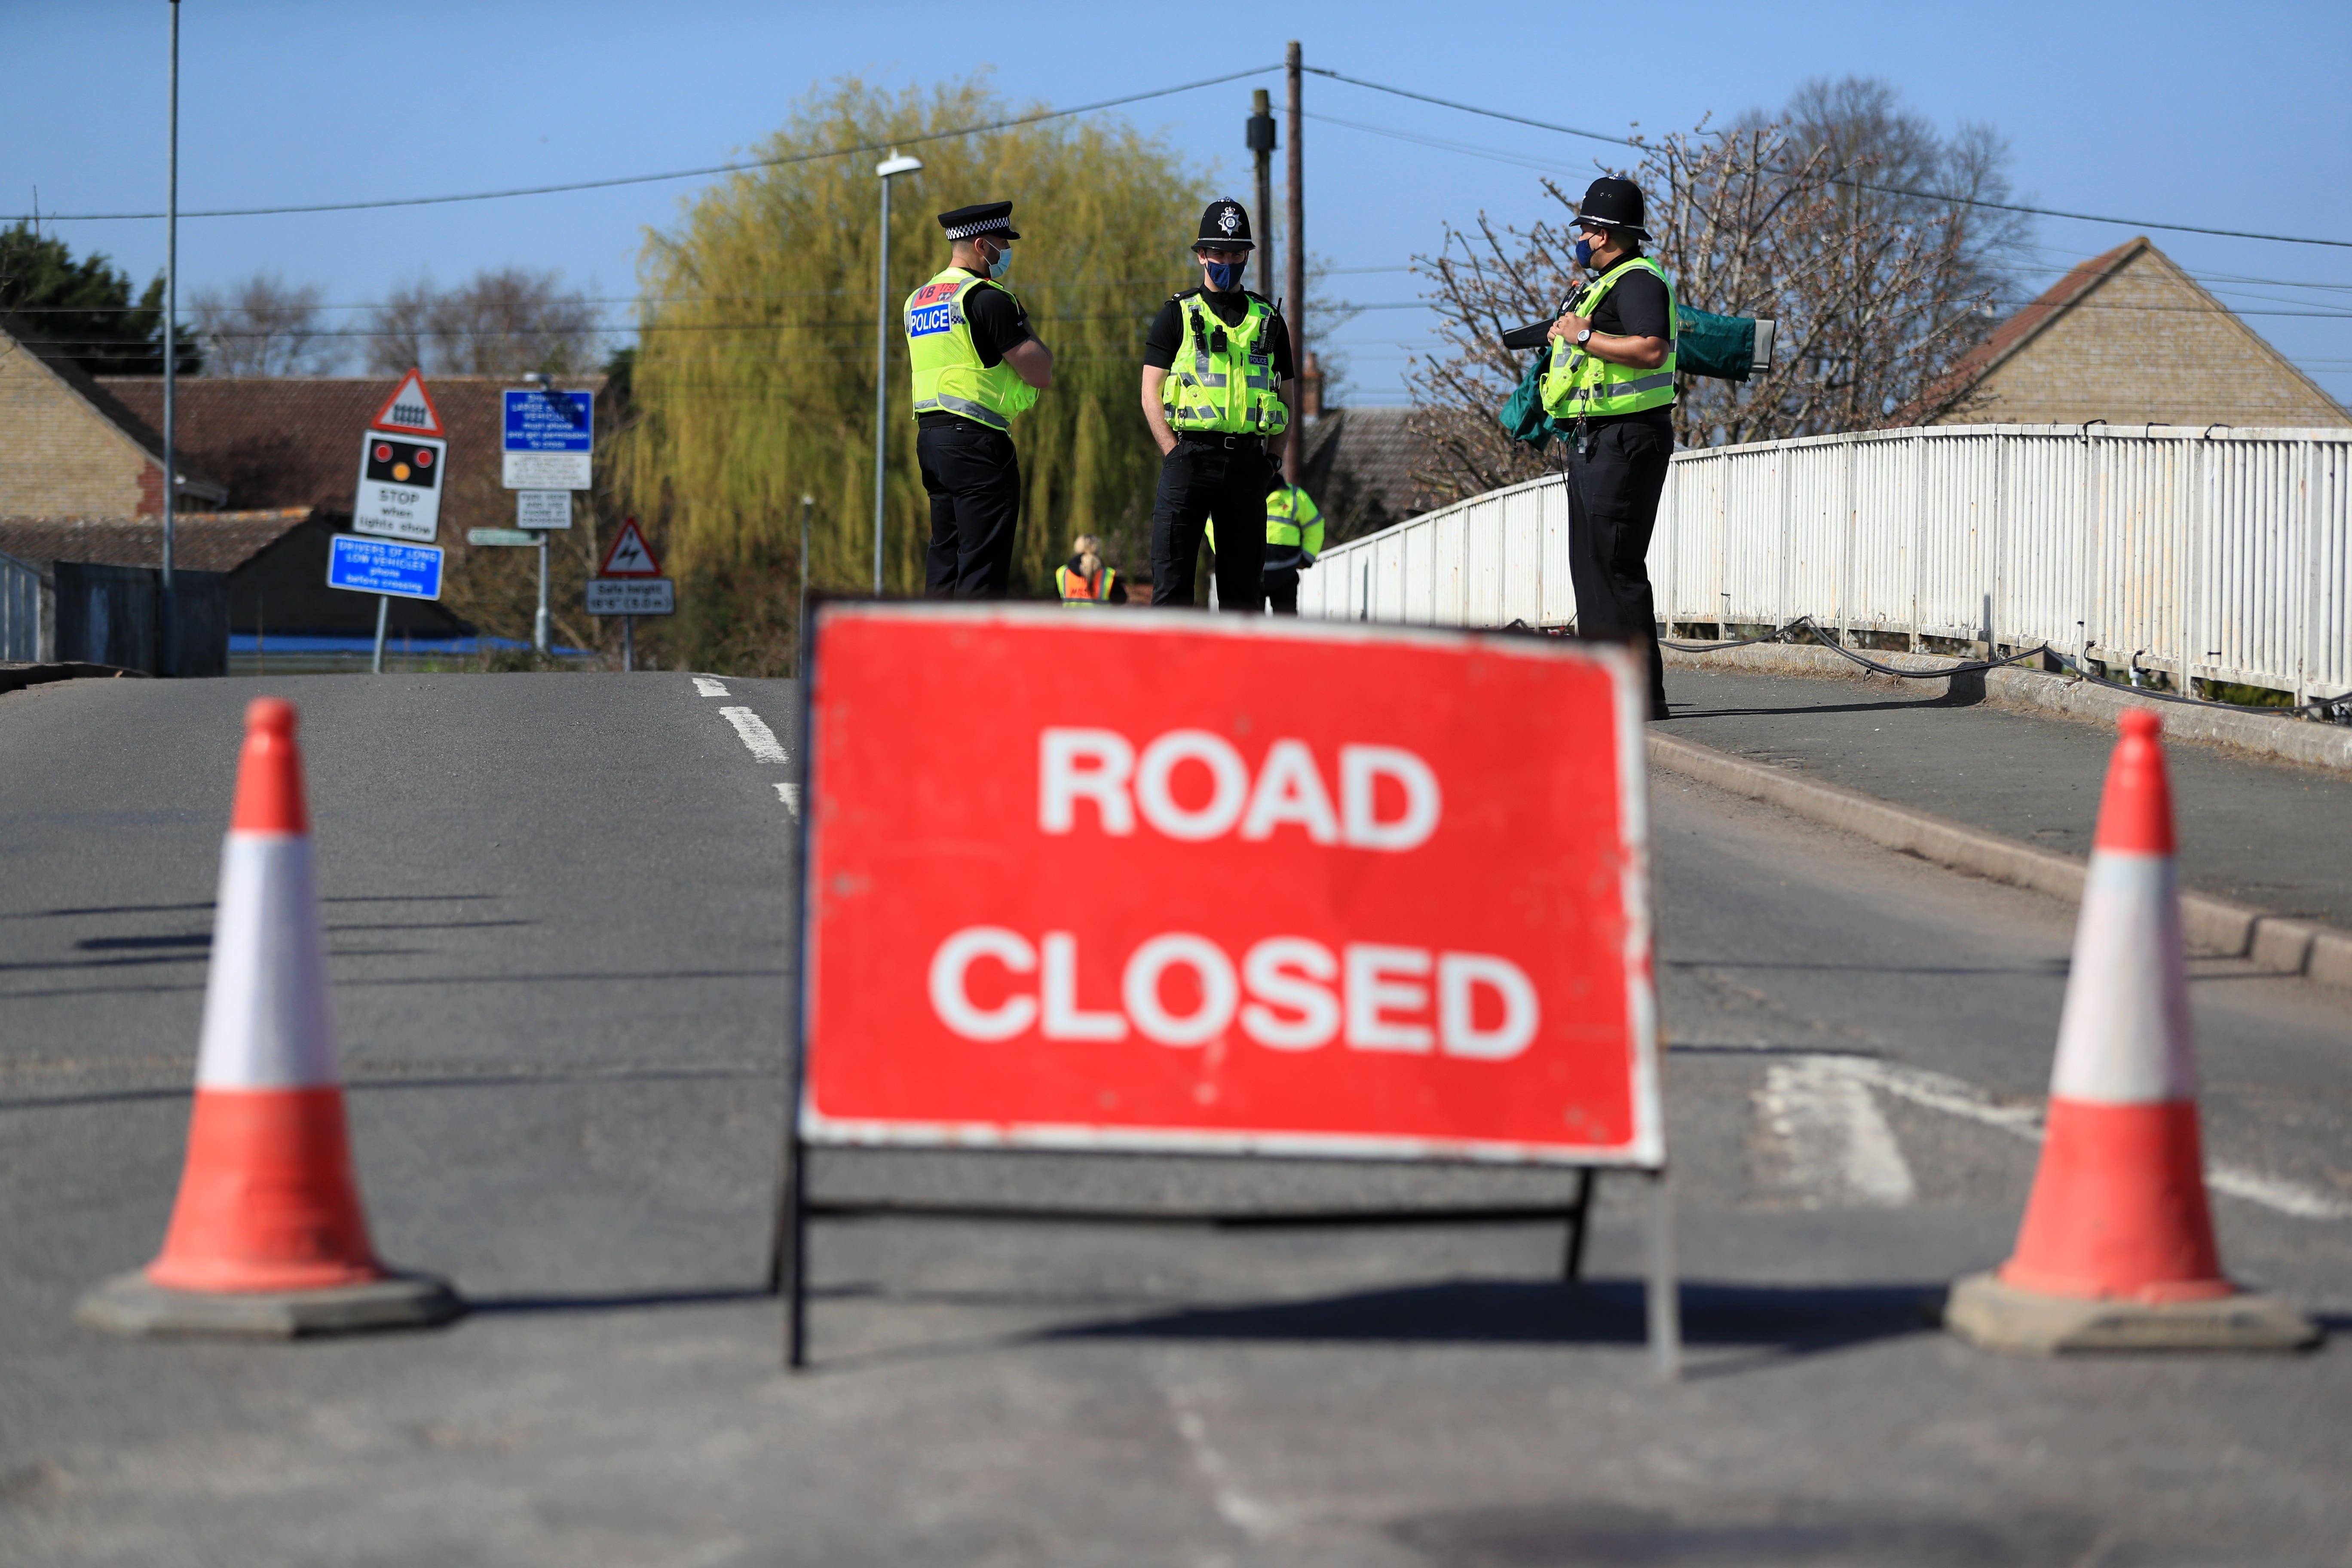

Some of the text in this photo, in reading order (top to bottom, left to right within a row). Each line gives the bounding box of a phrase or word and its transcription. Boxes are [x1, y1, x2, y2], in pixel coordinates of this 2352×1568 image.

[919, 286, 936, 300] VB
[911, 309, 949, 333] POLICE
[379, 488, 420, 504] STOP
[381, 507, 413, 518] when
[359, 516, 430, 533] lights show
[338, 541, 437, 563] DRIVERS OF LONG
[346, 552, 426, 572] LOW VEHICLES
[369, 566, 400, 579] phone
[346, 573, 423, 594] before crossing
[597, 583, 662, 597] Safe height
[1039, 727, 1441, 852] ROAD
[928, 926, 1541, 1062] CLOSED
